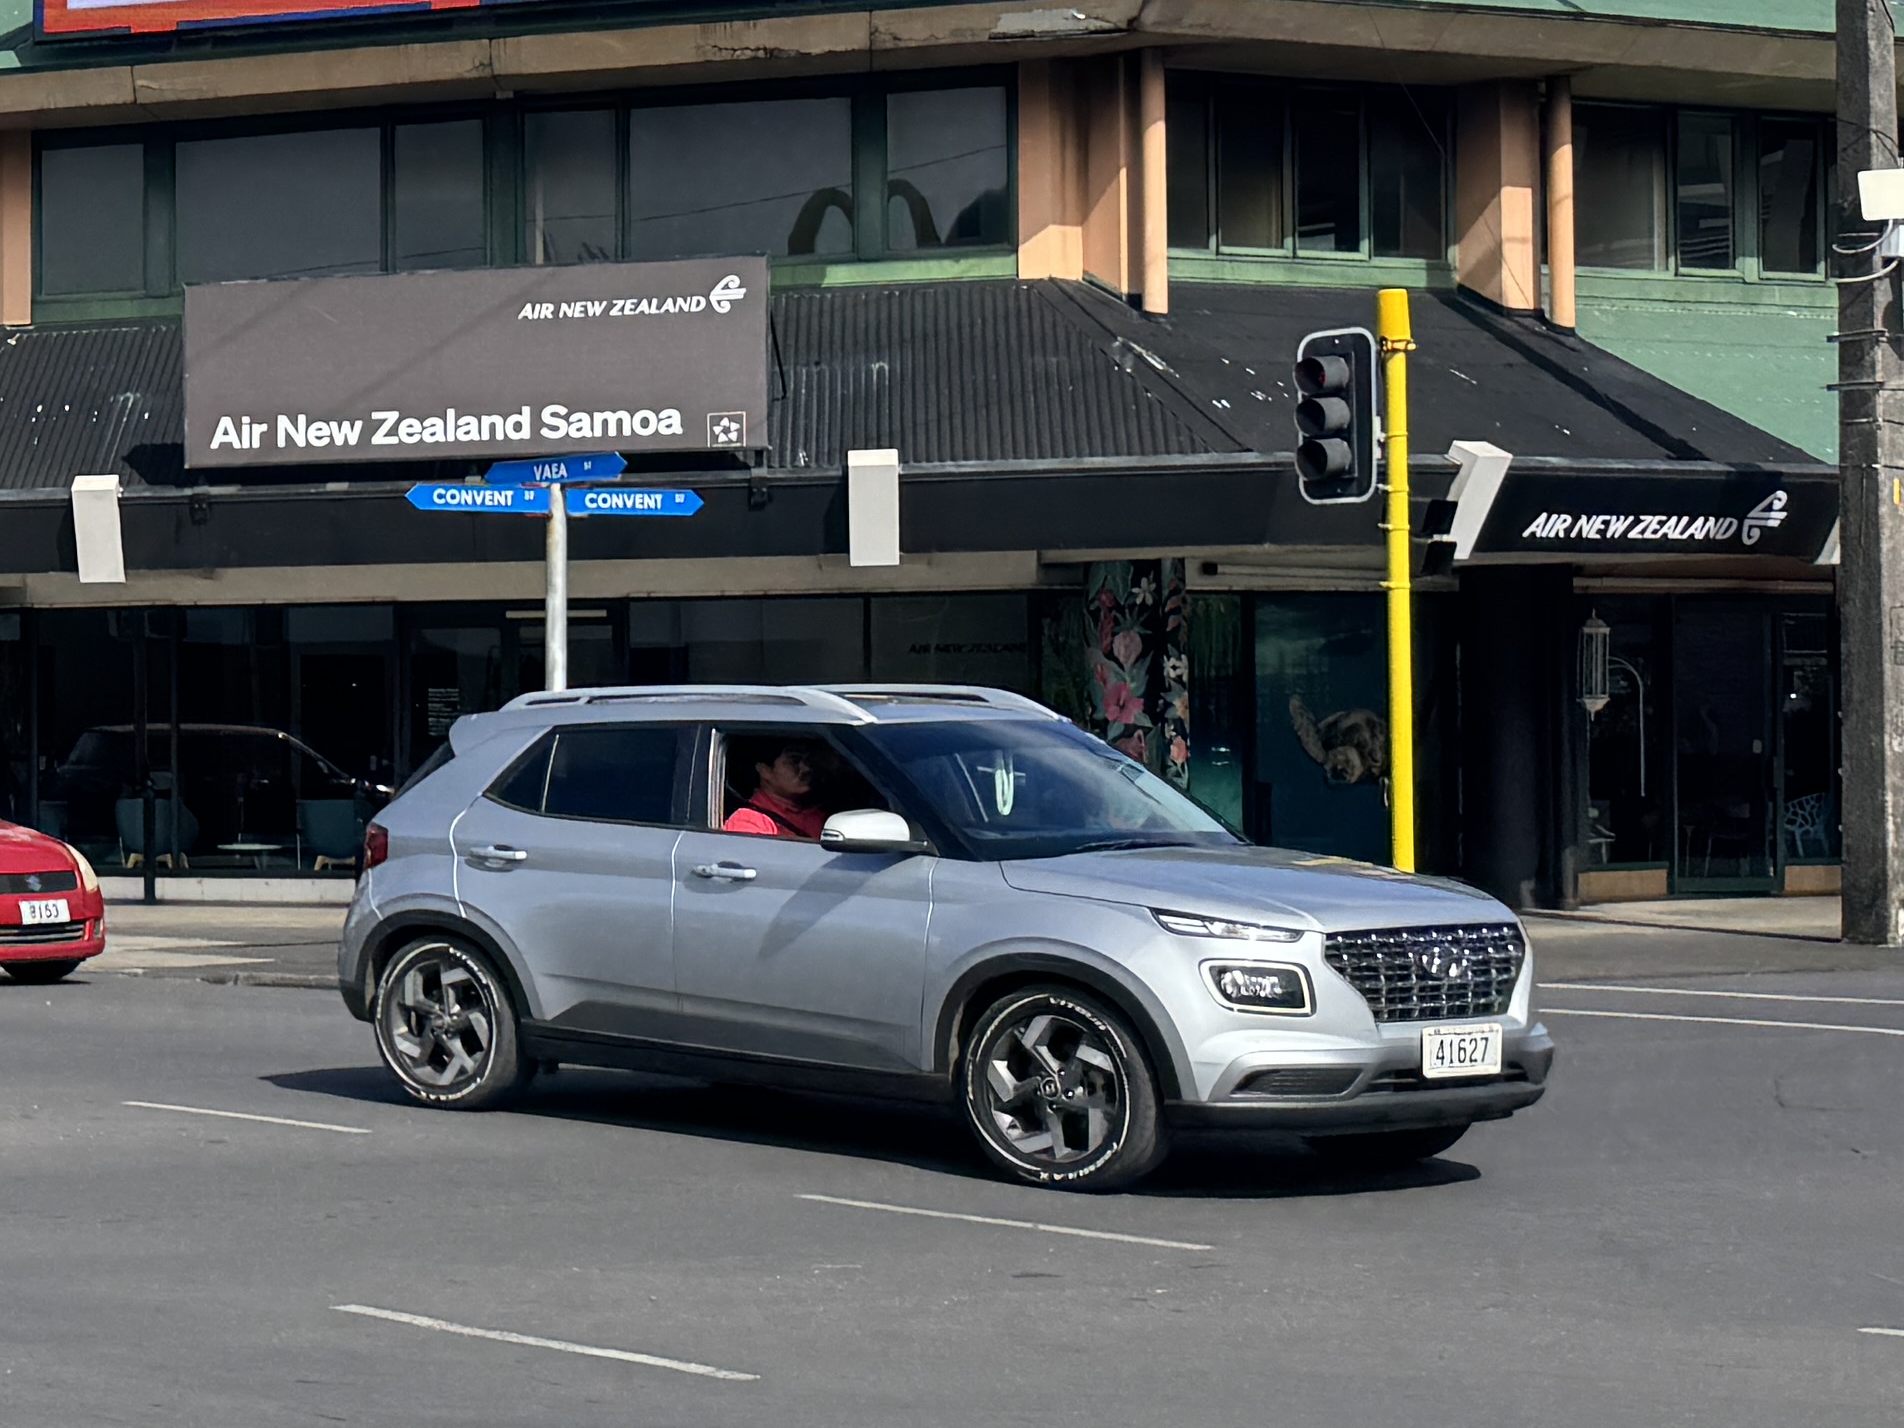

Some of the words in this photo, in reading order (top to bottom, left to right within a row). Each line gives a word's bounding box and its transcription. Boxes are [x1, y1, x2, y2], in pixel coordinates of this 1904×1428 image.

[518, 302, 553, 320] AIR
[558, 300, 607, 318] NEW
[609, 294, 706, 317] ZEALAND
[209, 415, 267, 449] Air
[277, 413, 363, 448] New
[371, 405, 531, 446] Zealand
[540, 403, 683, 440] Samoa
[533, 462, 568, 481] VAEA
[433, 488, 513, 507] CONVENT
[584, 492, 662, 510] CONVENT
[1522, 512, 1572, 539] AIR
[1569, 514, 1631, 539] NEW
[1627, 515, 1738, 540] ZEALAND
[1435, 1036, 1489, 1066] 41627
